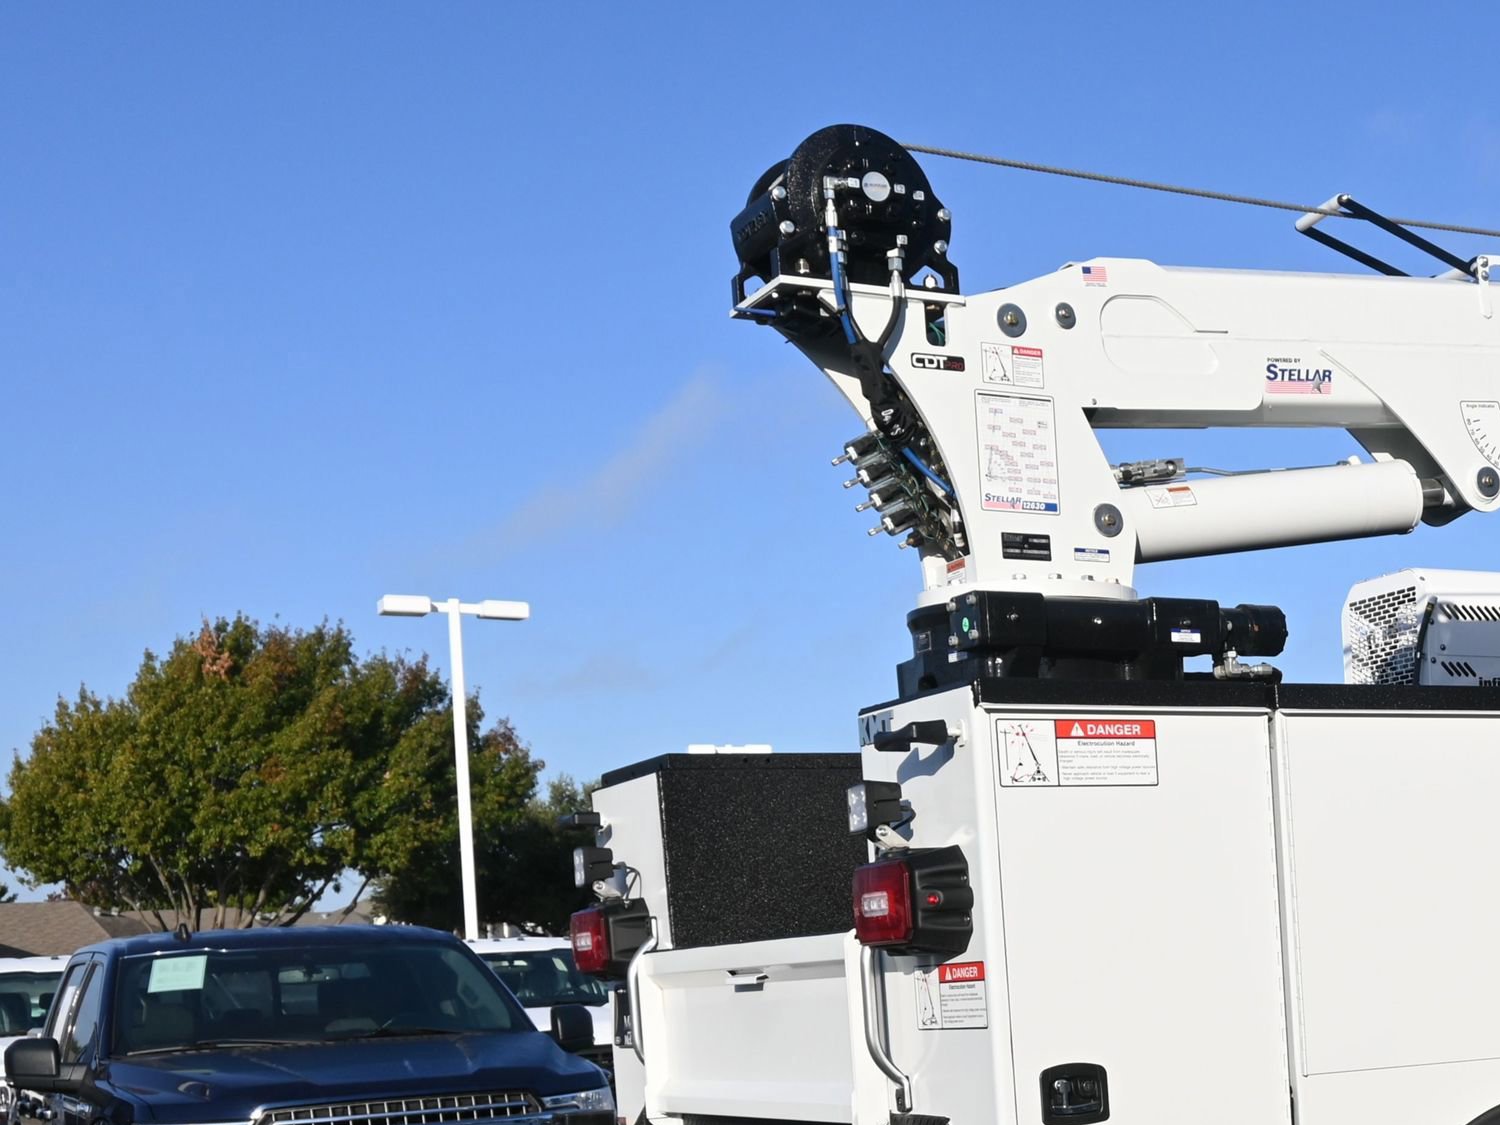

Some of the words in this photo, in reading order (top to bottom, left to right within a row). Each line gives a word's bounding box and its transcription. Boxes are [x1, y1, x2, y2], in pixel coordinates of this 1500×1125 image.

[912, 353, 948, 369] CDT
[1023, 501, 1046, 510] 12630
[1087, 724, 1141, 736] DANGER
[952, 967, 978, 978] DANGER
